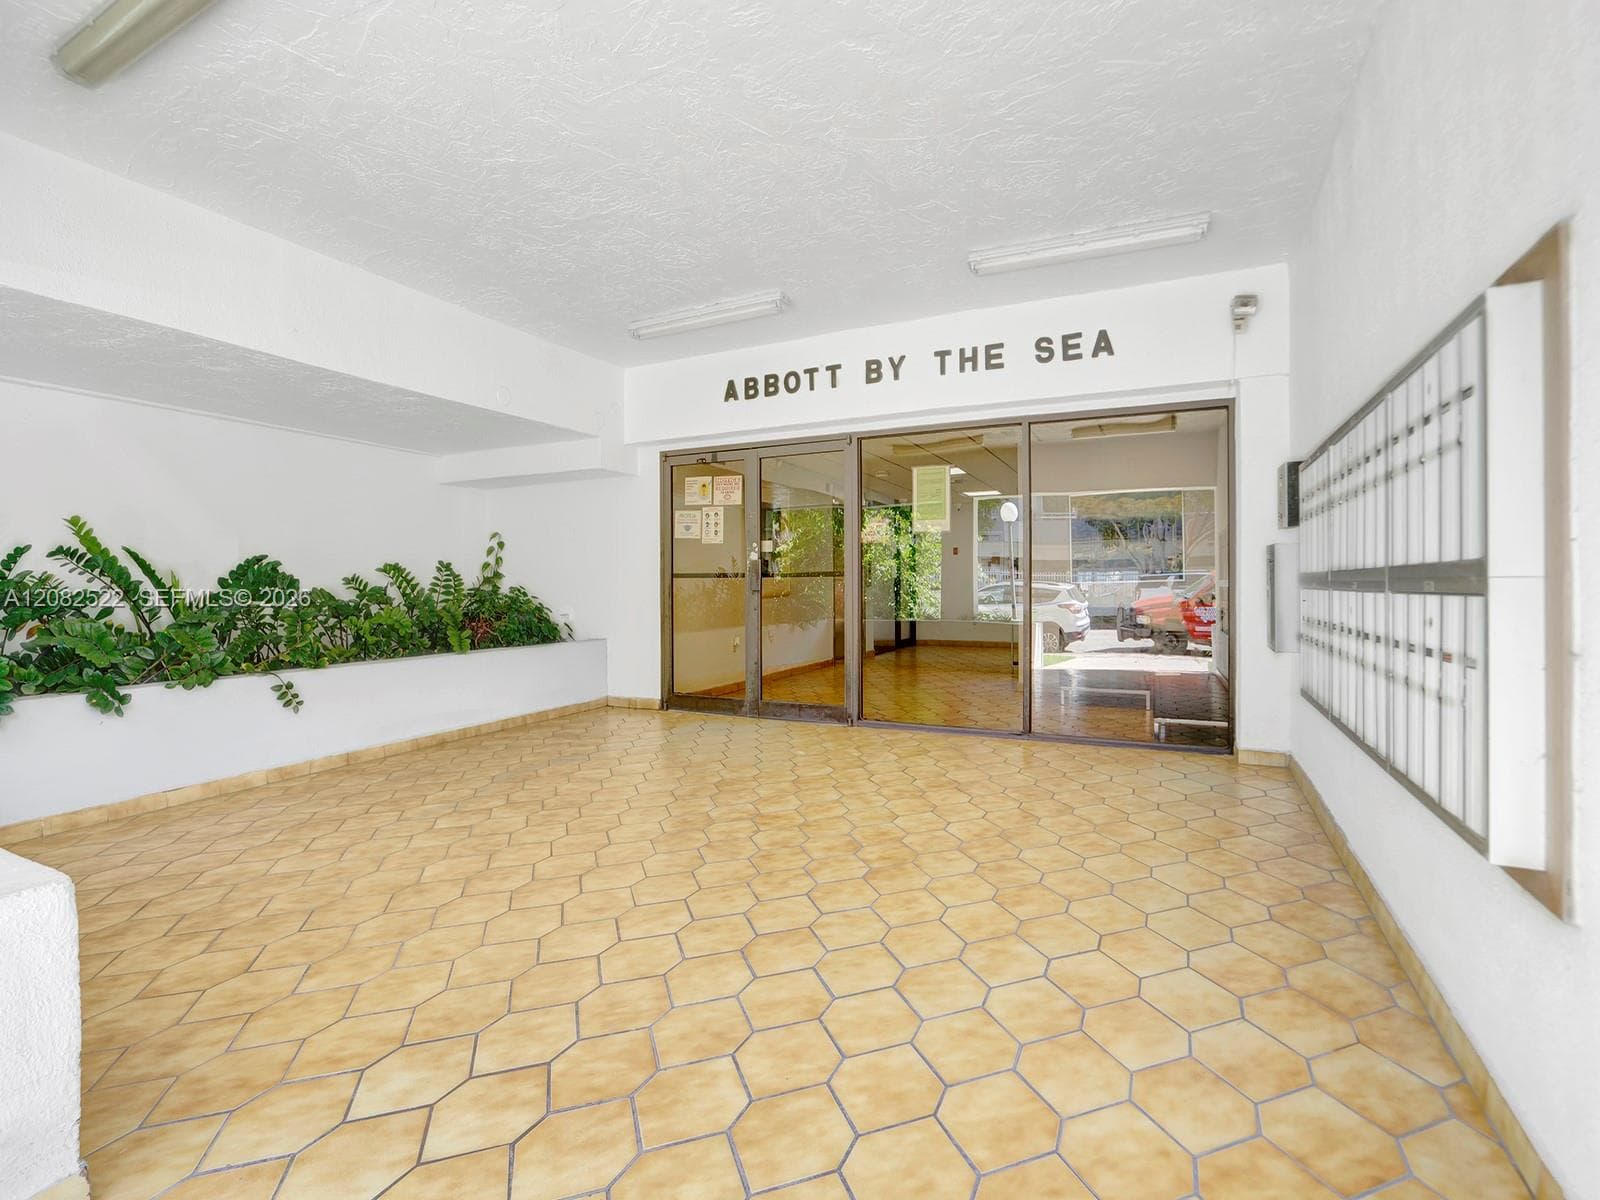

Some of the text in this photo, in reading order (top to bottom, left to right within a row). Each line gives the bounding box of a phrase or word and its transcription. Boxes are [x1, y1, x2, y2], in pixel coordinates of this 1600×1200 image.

[723, 329, 1115, 403] ABBOTT BY THE SEA
